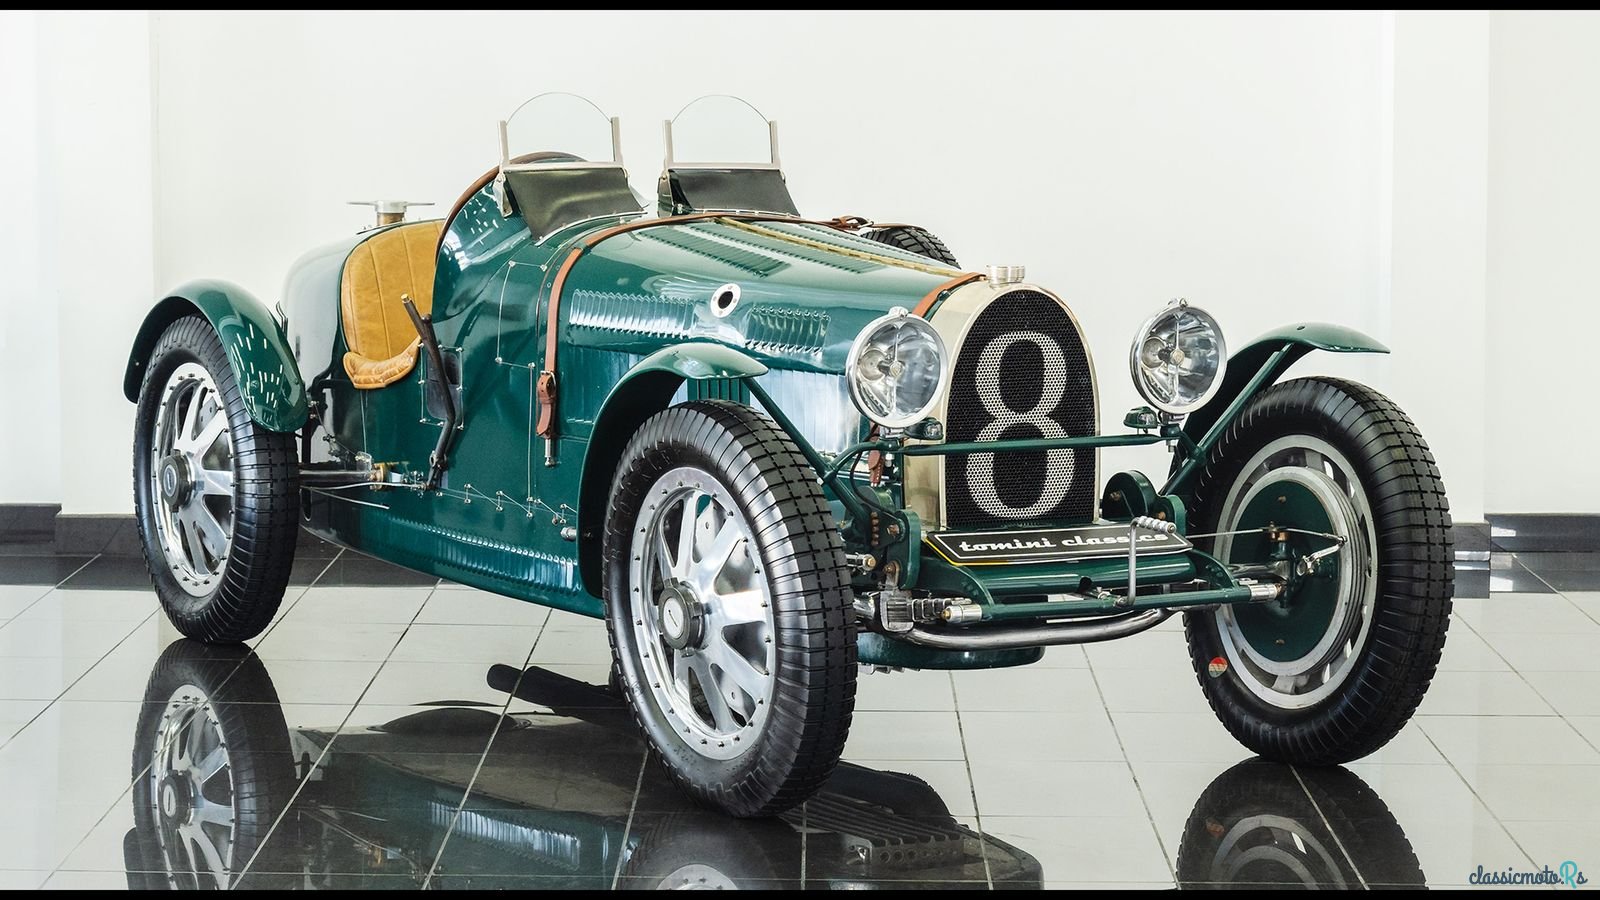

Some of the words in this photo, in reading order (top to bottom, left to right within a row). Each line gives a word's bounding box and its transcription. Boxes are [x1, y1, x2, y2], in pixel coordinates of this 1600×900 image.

[966, 331, 1075, 519] 8
[960, 538, 1056, 552] tomini
[1062, 532, 1169, 547] classcs
